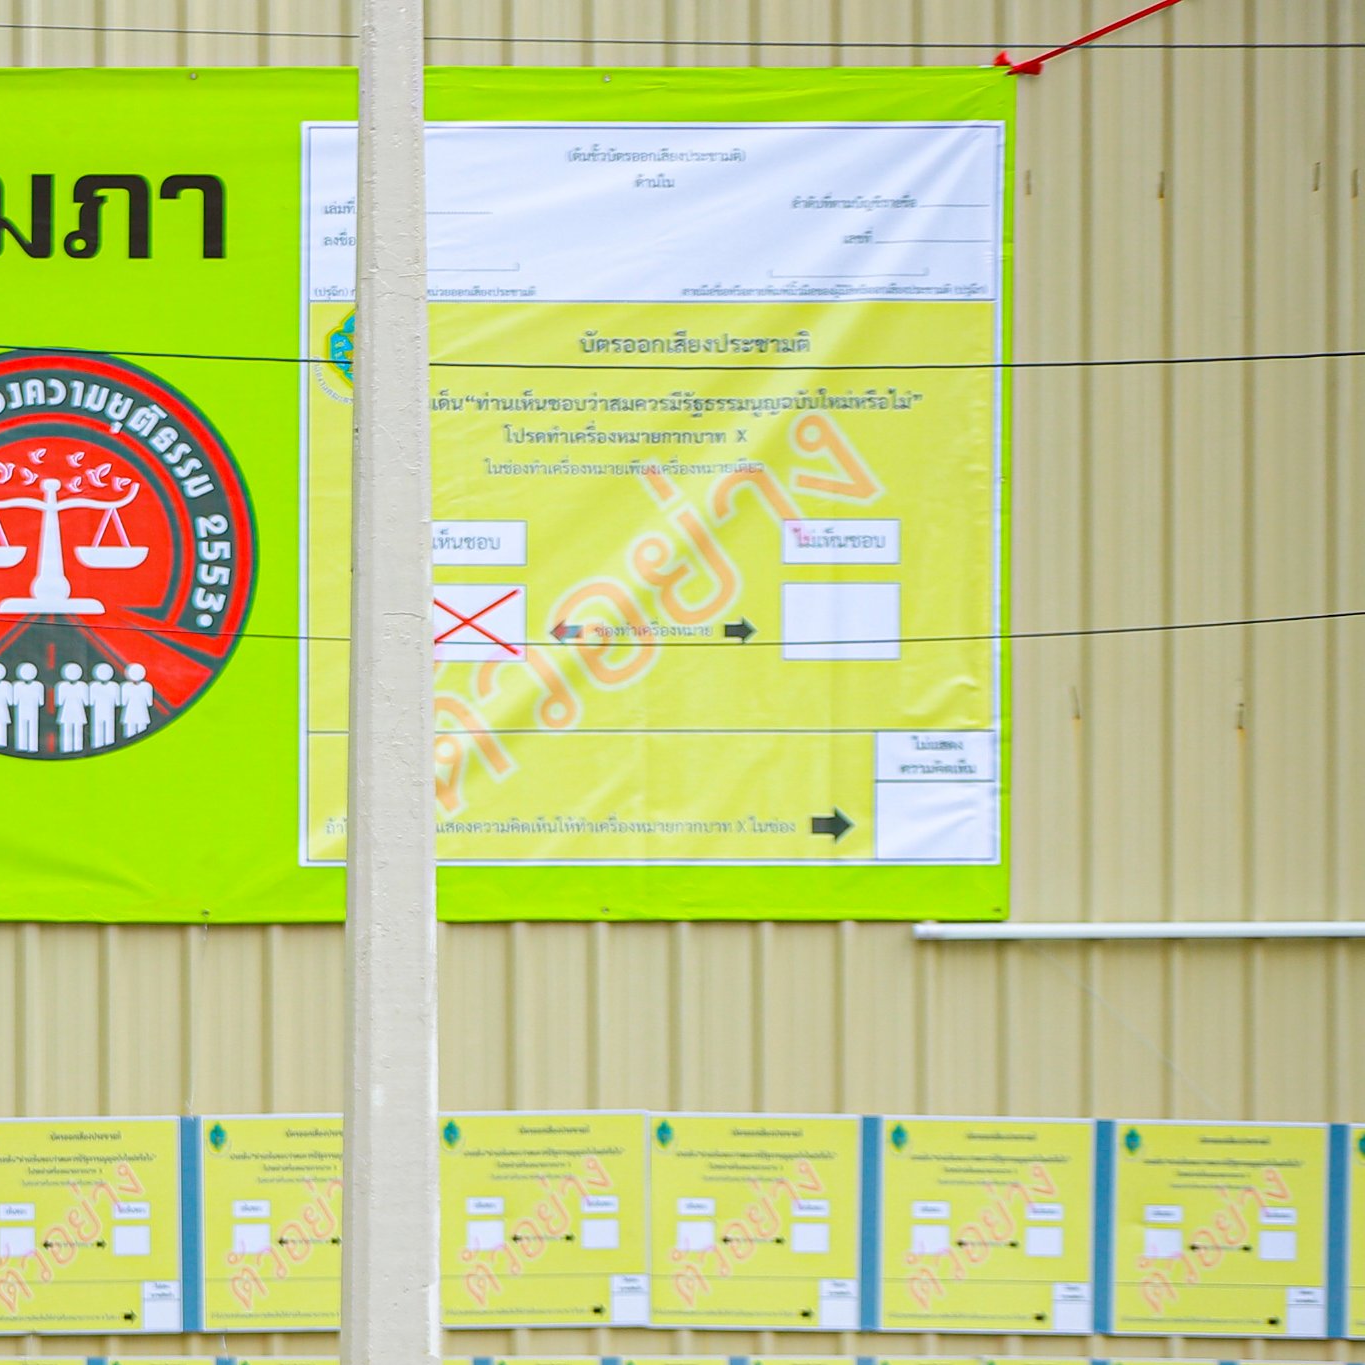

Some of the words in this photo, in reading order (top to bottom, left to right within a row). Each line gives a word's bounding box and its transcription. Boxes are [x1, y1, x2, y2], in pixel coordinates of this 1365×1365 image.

[580, 330, 810, 354] บัตรออกเสียงประชามติ
[195, 514, 232, 613] 2553
